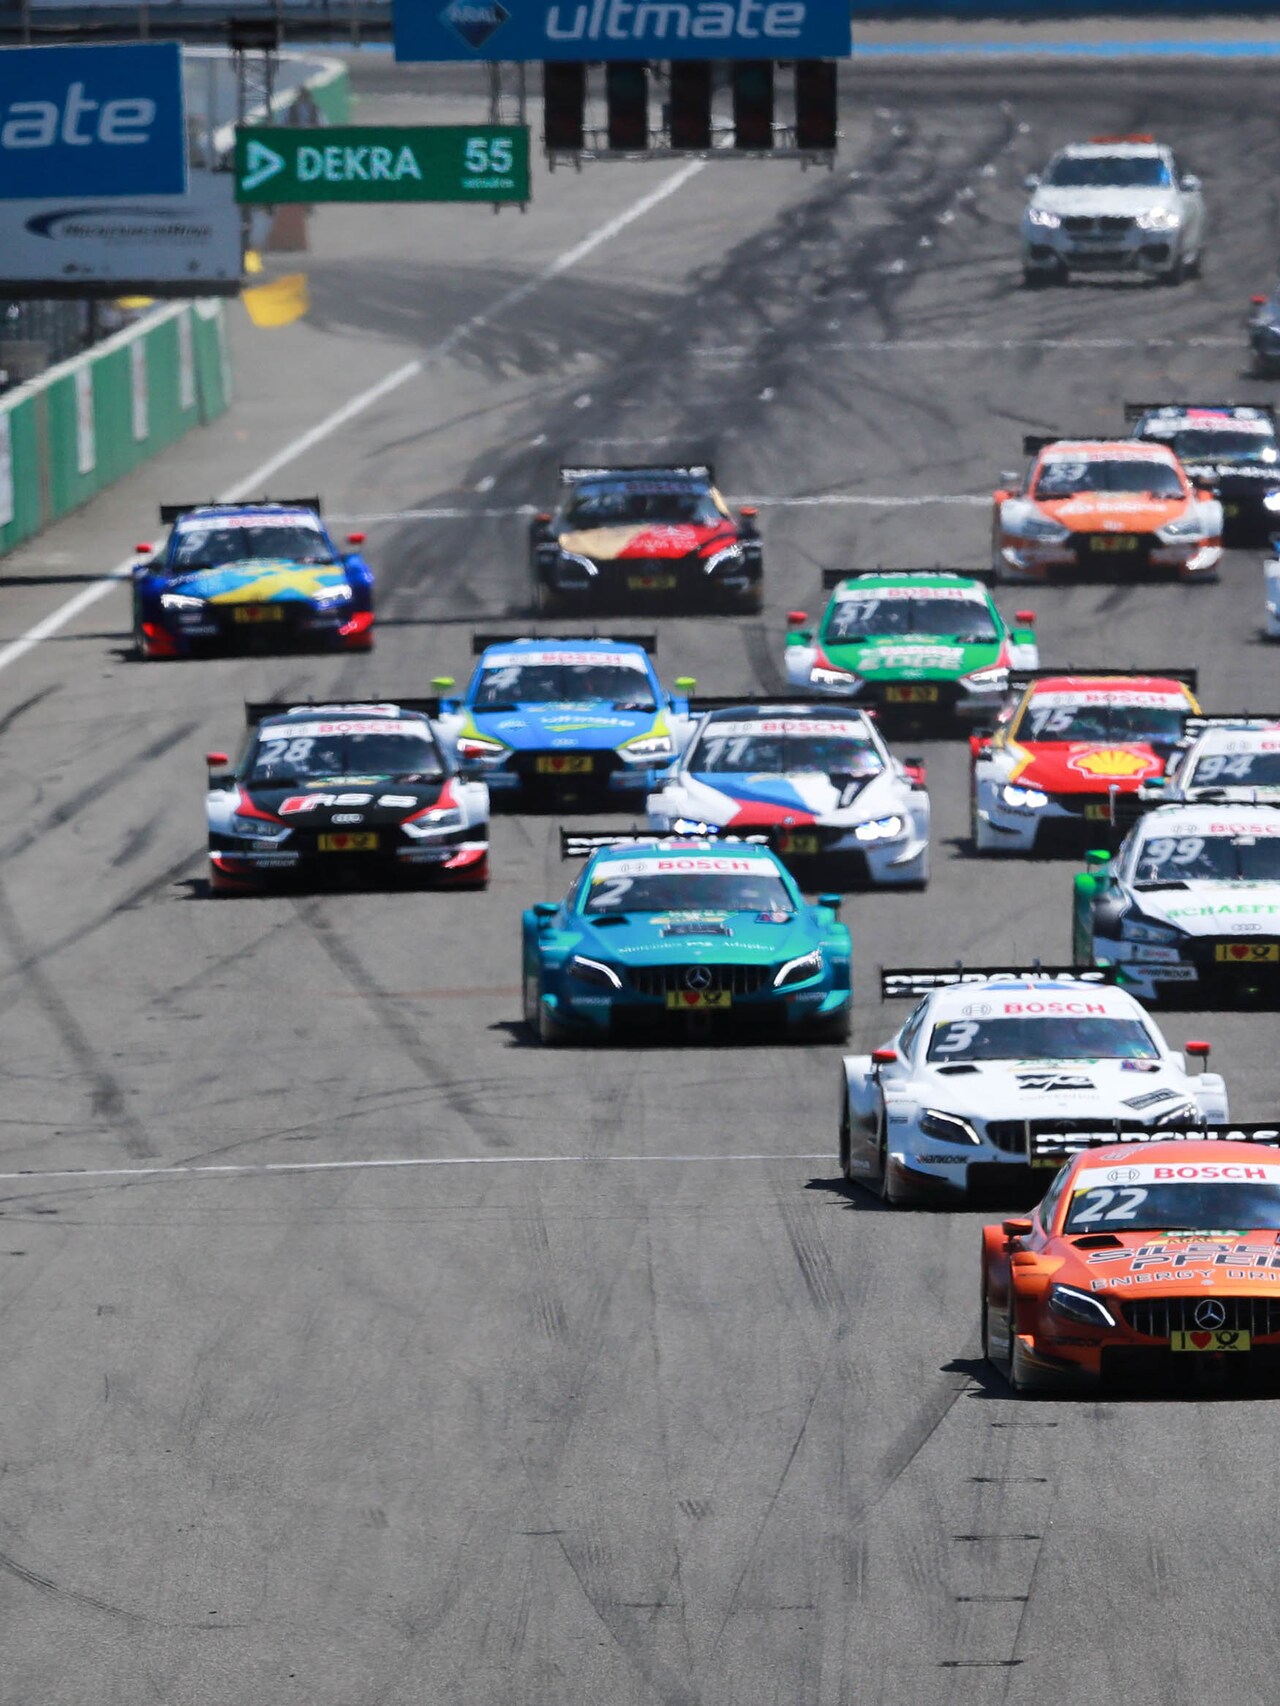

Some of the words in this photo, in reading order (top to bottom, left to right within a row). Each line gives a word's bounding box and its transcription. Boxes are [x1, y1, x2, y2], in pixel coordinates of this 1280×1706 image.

[296, 145, 422, 182] DEKRA
[464, 137, 514, 173] 55
[319, 723, 404, 734] BOSCH
[761, 722, 847, 733] BOSCH
[257, 738, 317, 767] 28
[1196, 754, 1256, 782] 94
[658, 860, 750, 871] BOSCH
[1142, 838, 1206, 866] 99
[590, 877, 634, 907] 2
[1004, 1002, 1106, 1014] BOSCH
[934, 1020, 980, 1053] 3
[1153, 1167, 1267, 1180] BOSCH
[1072, 1188, 1149, 1224] 22
[1090, 1269, 1217, 1292] ENERGY
